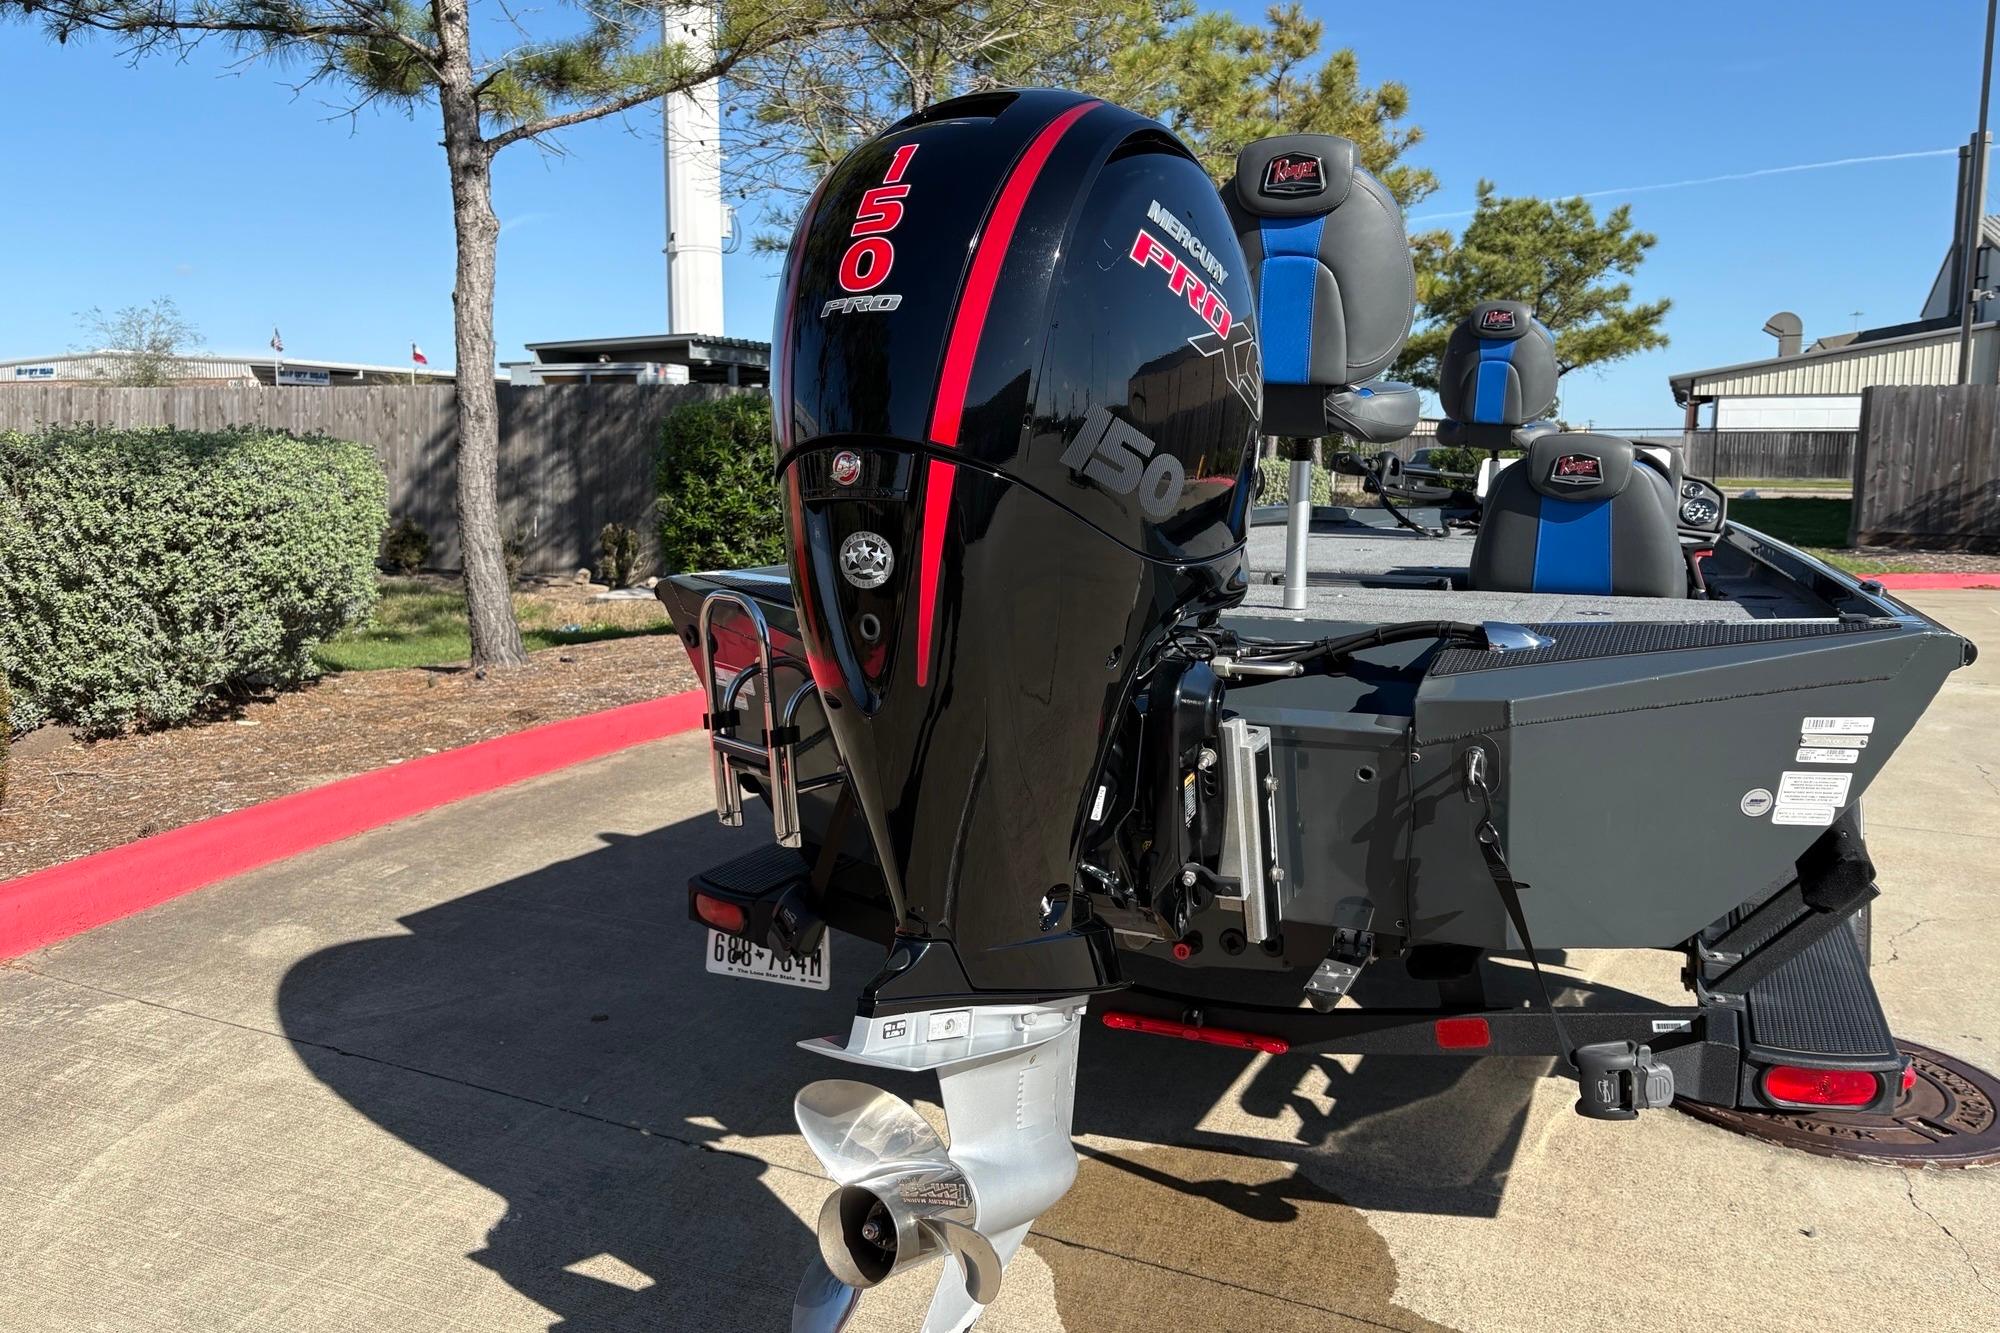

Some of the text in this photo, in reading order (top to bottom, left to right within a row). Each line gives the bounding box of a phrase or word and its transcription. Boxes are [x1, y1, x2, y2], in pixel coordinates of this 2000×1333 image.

[838, 143, 921, 293] 150
[1146, 199, 1230, 286] MERCURY
[820, 294, 903, 318] PRO
[1129, 228, 1233, 340] PRO
[1059, 402, 1186, 518] 150
[750, 969, 764, 977] Lone
